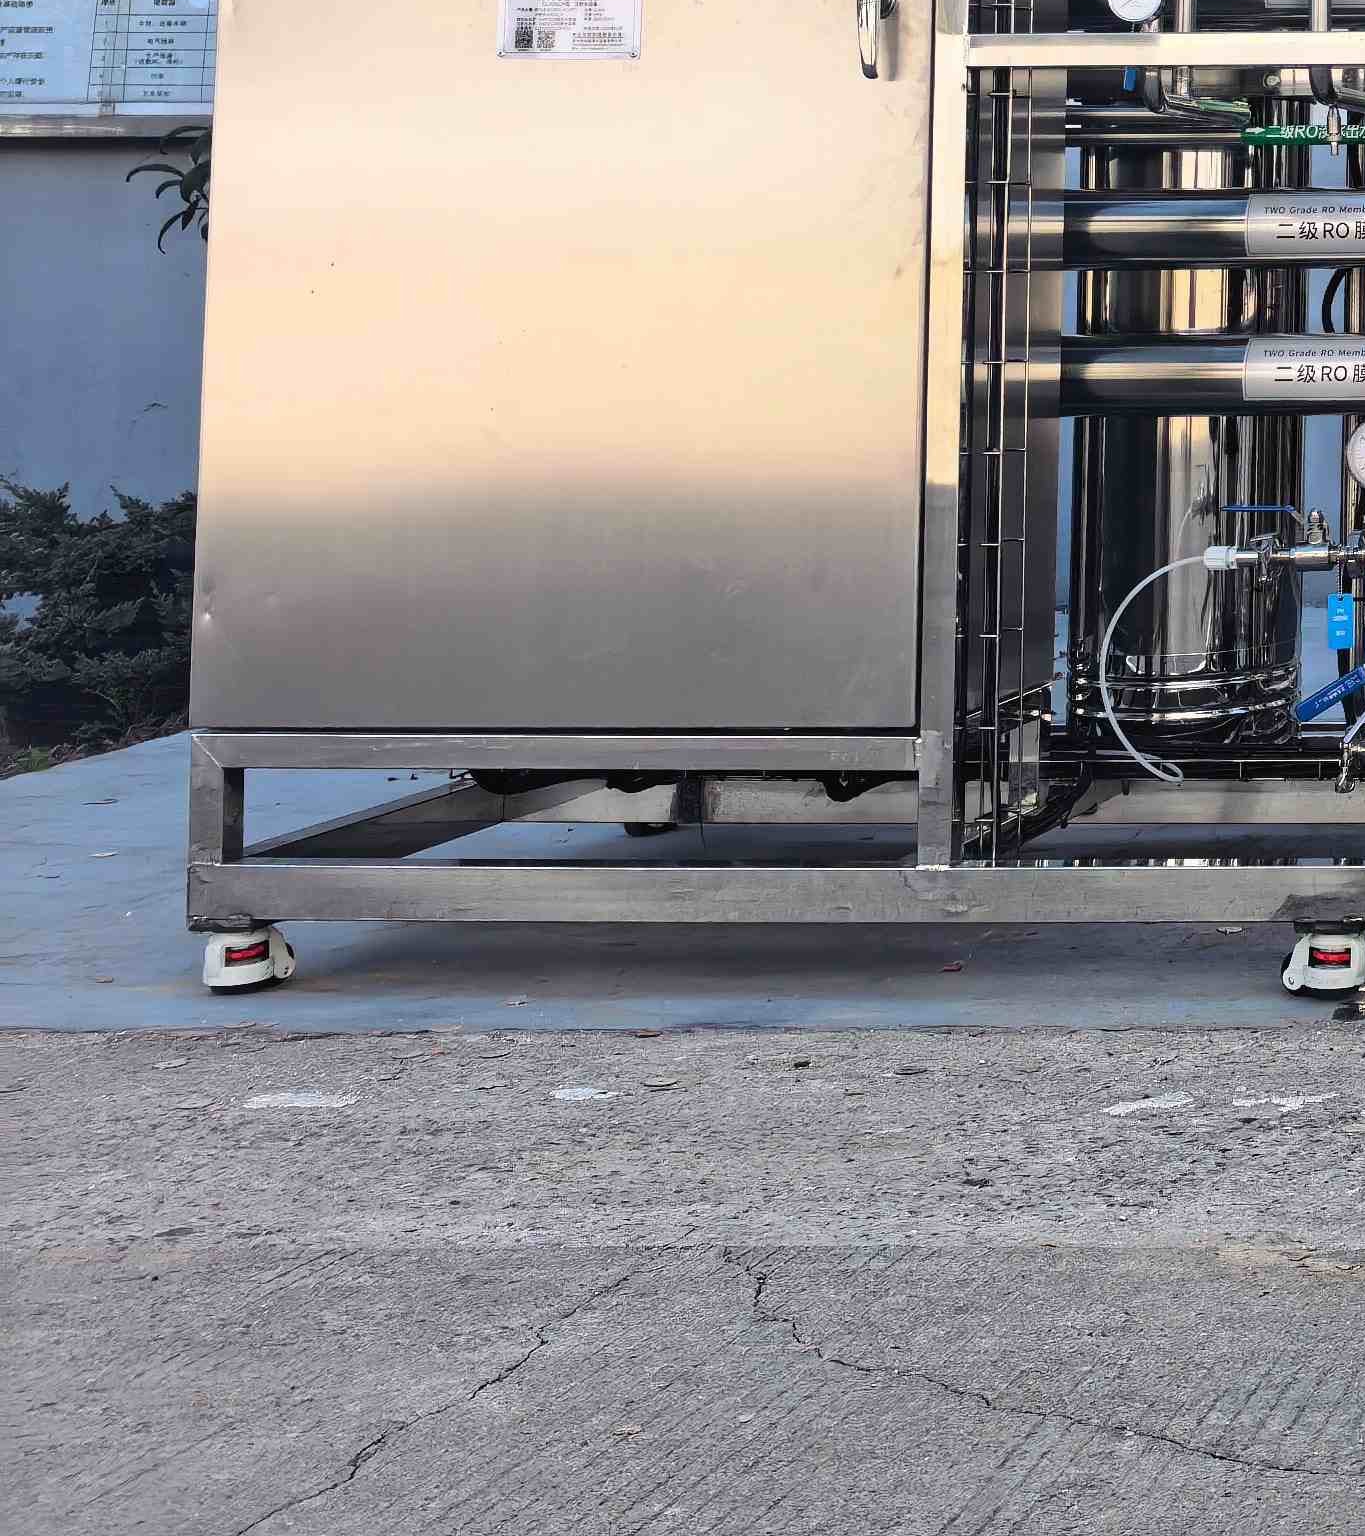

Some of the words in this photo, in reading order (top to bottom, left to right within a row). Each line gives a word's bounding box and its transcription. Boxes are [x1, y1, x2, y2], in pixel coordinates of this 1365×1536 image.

[1264, 206, 1285, 215] TWO
[1289, 205, 1318, 215] Grade
[1321, 205, 1336, 214] RO
[1264, 349, 1285, 358] TWO
[1288, 349, 1317, 357] Grade
[1319, 349, 1335, 357] RO
